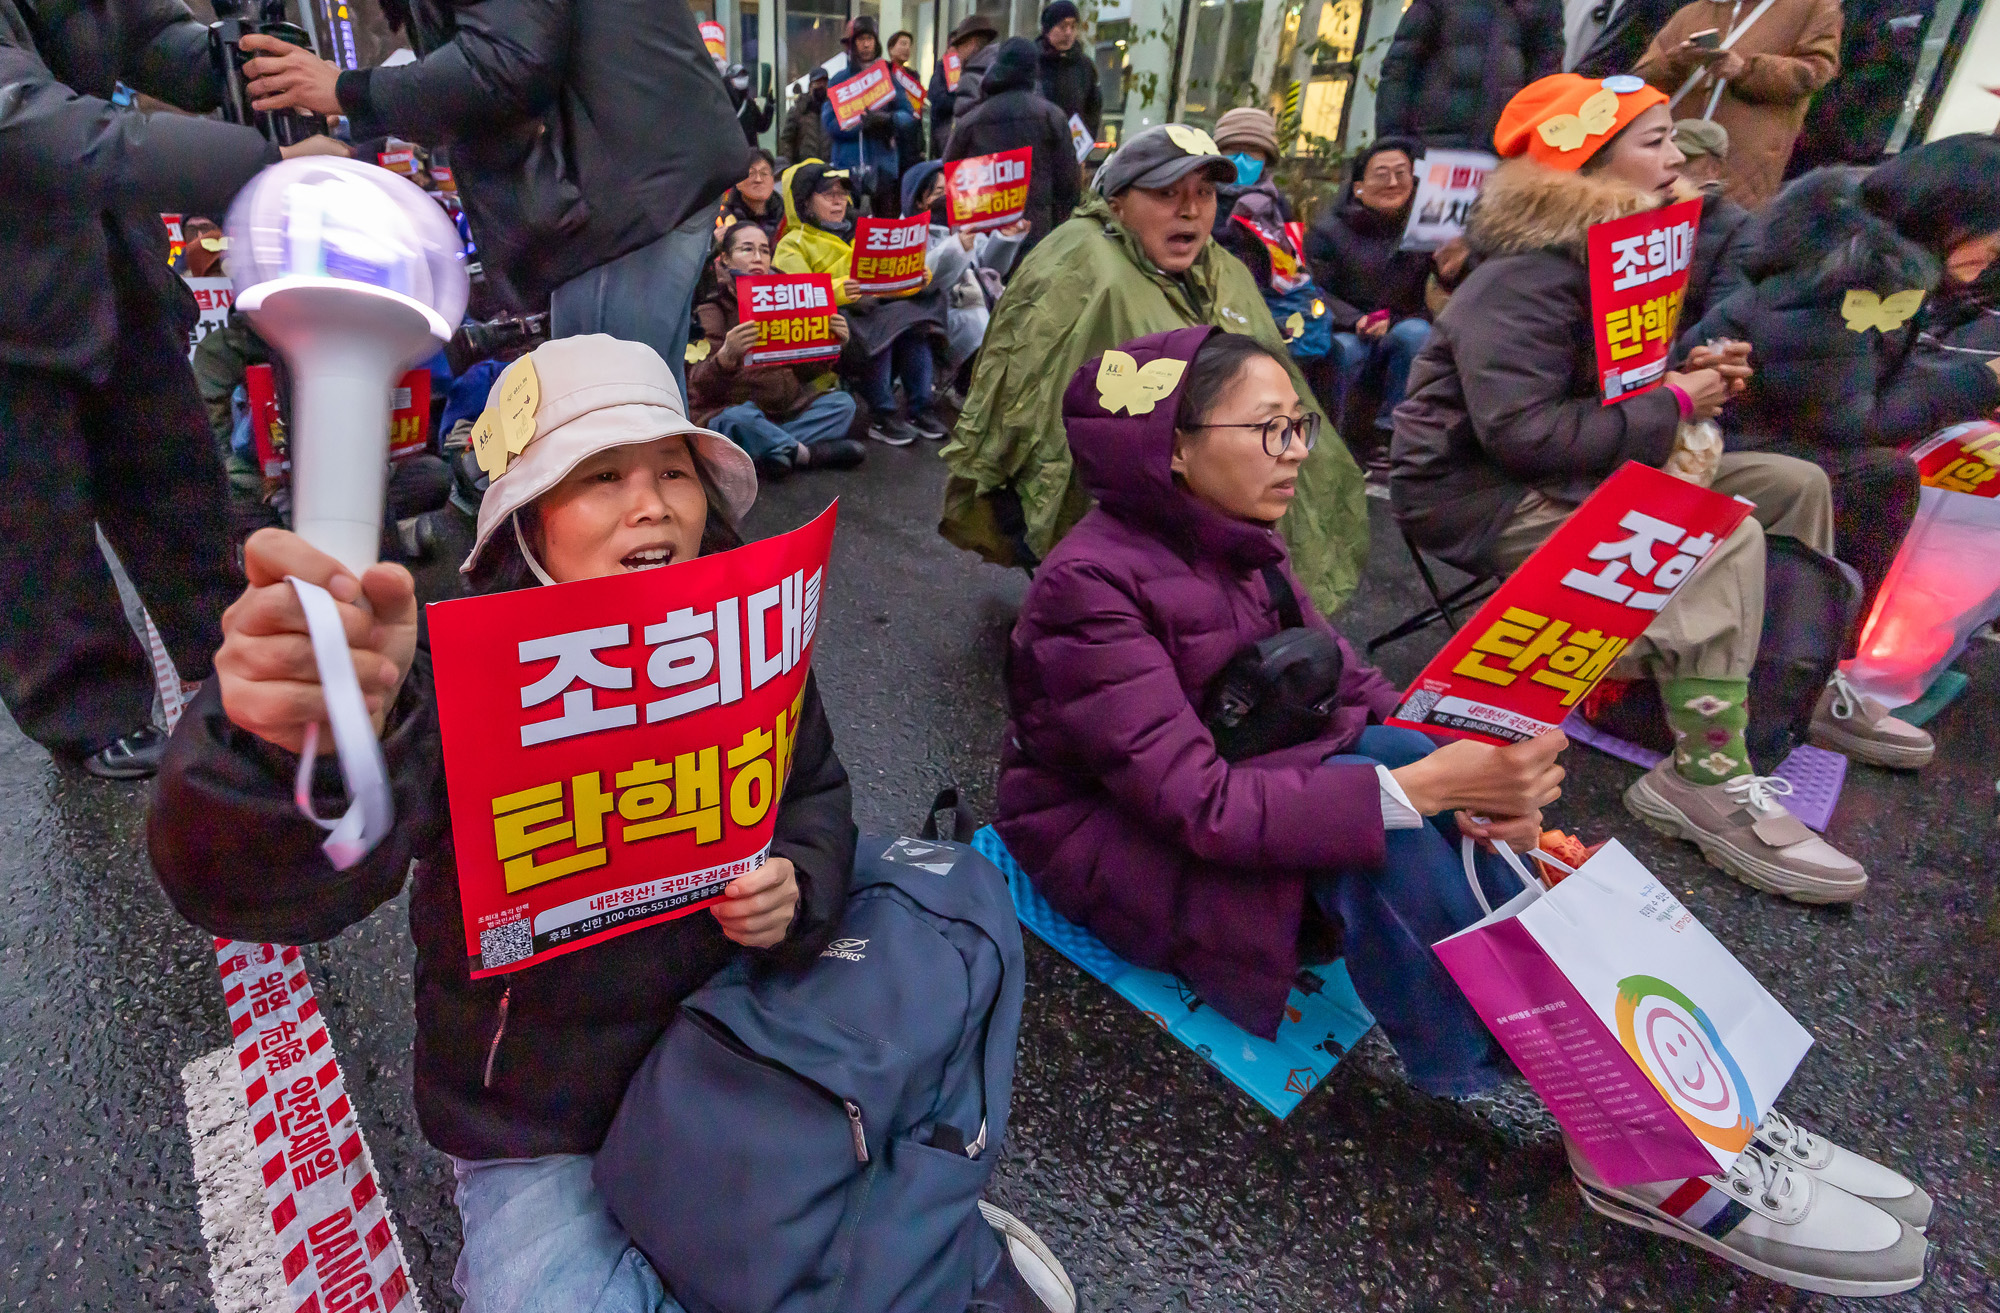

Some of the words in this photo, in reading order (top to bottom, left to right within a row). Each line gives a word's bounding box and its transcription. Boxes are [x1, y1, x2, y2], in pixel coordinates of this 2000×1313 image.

[752, 283, 829, 312] 조희대를
[518, 565, 822, 747] 조희대를
[589, 884, 656, 911] 내란청산!
[661, 862, 750, 893] 국민주권실현!
[549, 927, 571, 942] 후원
[582, 919, 602, 932] 신한
[606, 895, 688, 924] 100-036-551308
[248, 971, 291, 1019] 위험
[273, 1075, 340, 1193] 안전제일
